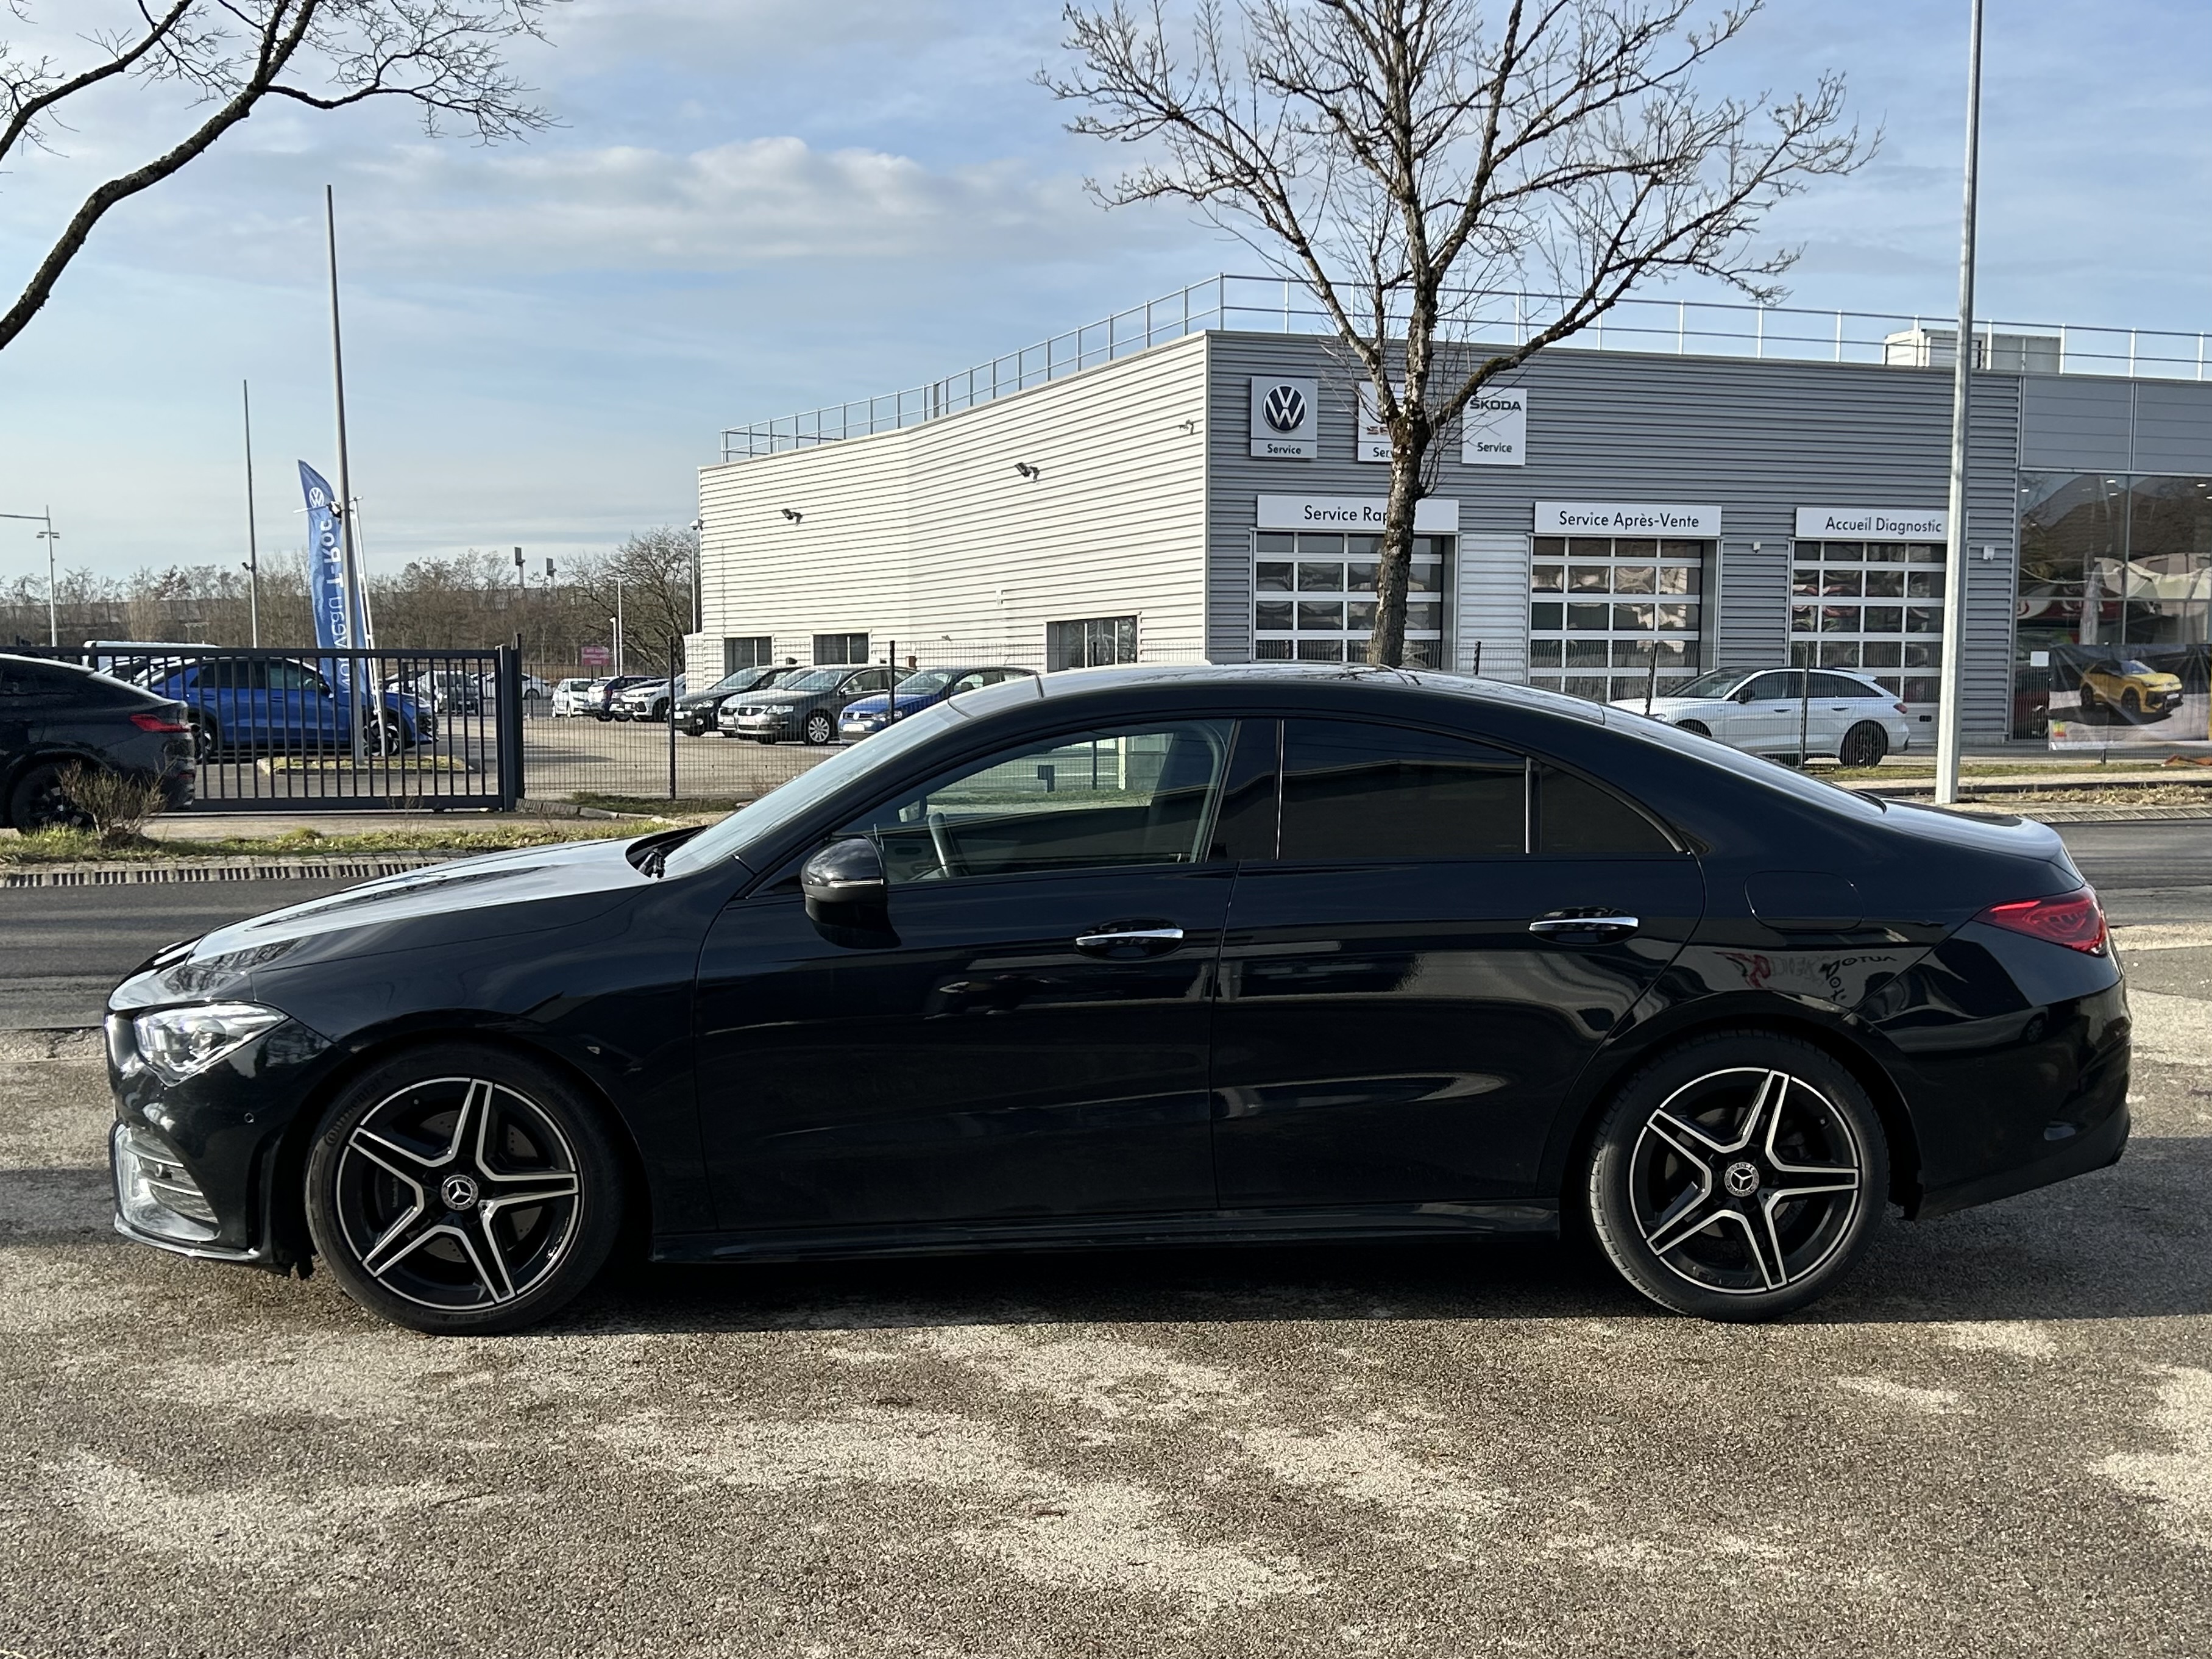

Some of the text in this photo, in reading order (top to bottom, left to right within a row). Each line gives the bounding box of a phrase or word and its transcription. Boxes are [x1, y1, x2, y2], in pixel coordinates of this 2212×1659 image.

[1469, 397, 1522, 411] ŠKODA
[1267, 443, 1302, 455] Service
[1373, 447, 1394, 458] Serv
[1476, 442, 1512, 453] Service
[1304, 505, 1388, 525] Service Rap
[1559, 510, 1700, 530] Service Après-Vente
[1825, 516, 1942, 535] Accueil Diagnostic
